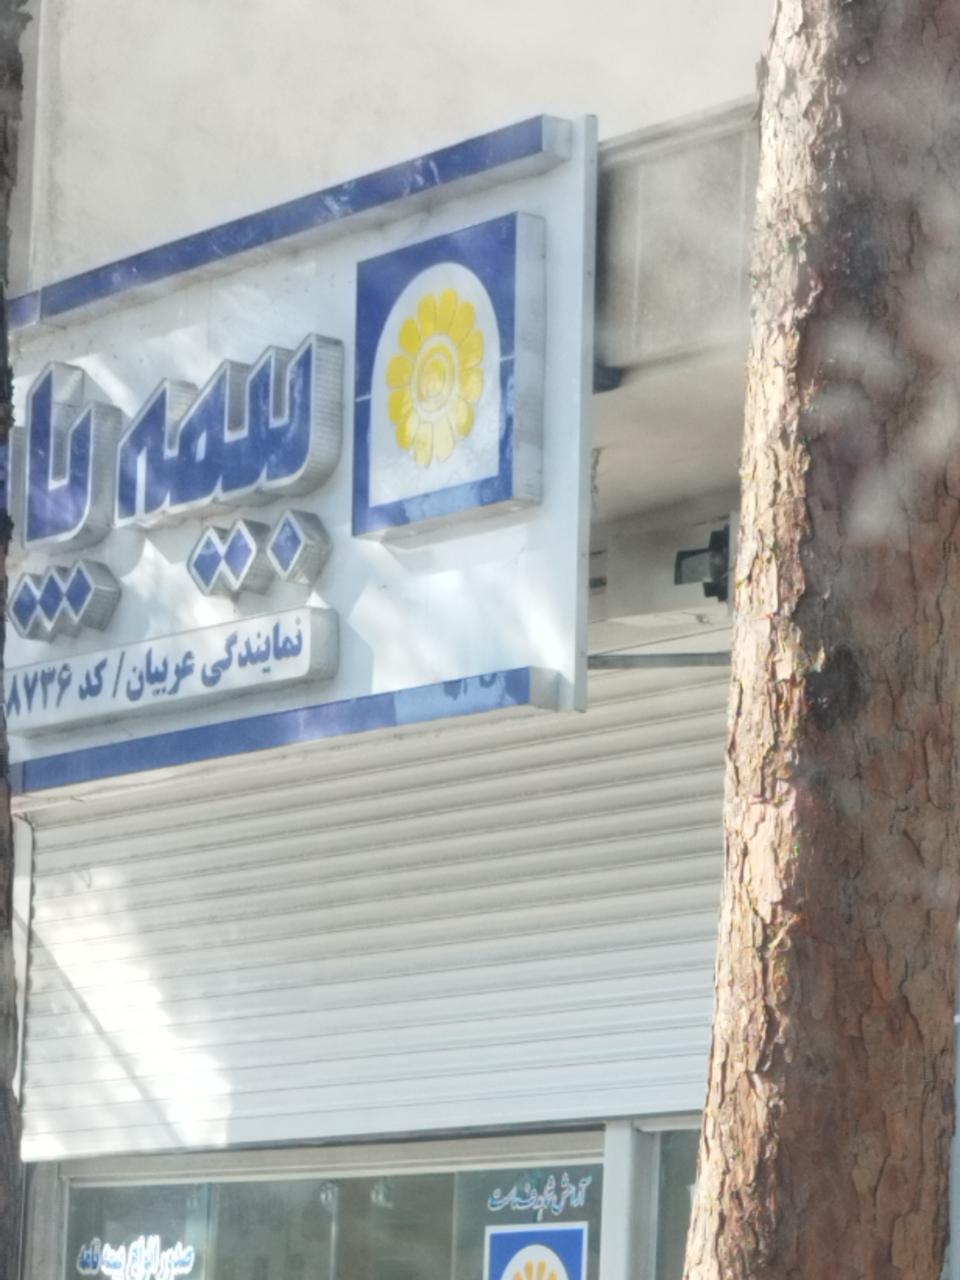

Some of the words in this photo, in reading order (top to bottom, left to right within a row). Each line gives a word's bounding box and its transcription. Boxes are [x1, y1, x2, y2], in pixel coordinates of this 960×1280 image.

[78, 658, 108, 700] کد
[201, 618, 304, 687] نمایندگی
[5, 663, 72, 718] ۸۷۳۶
